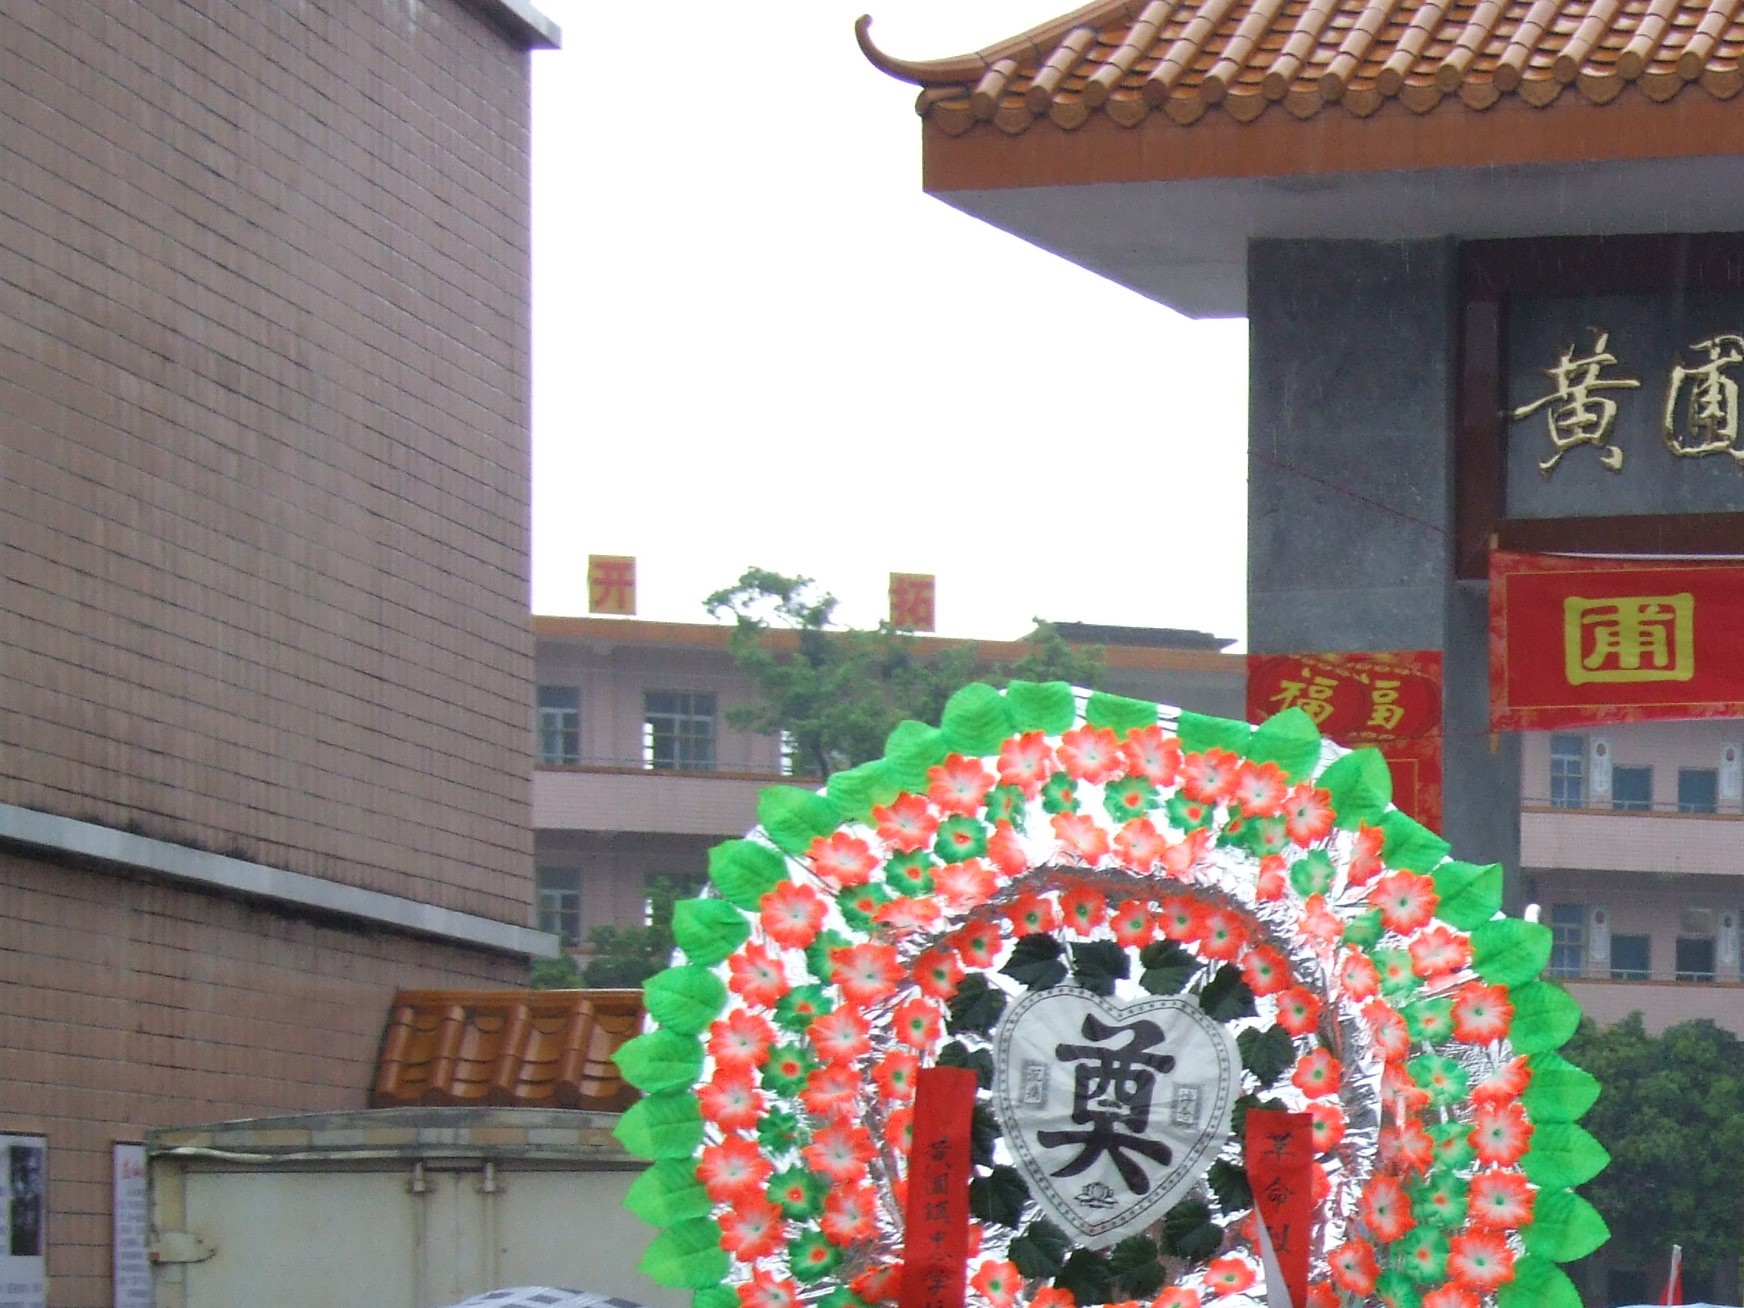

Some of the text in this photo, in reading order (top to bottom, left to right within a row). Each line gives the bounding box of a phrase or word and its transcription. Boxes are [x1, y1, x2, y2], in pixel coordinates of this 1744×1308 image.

[593, 561, 934, 626] 开 拓
[1036, 1013, 1176, 1196] 奠
